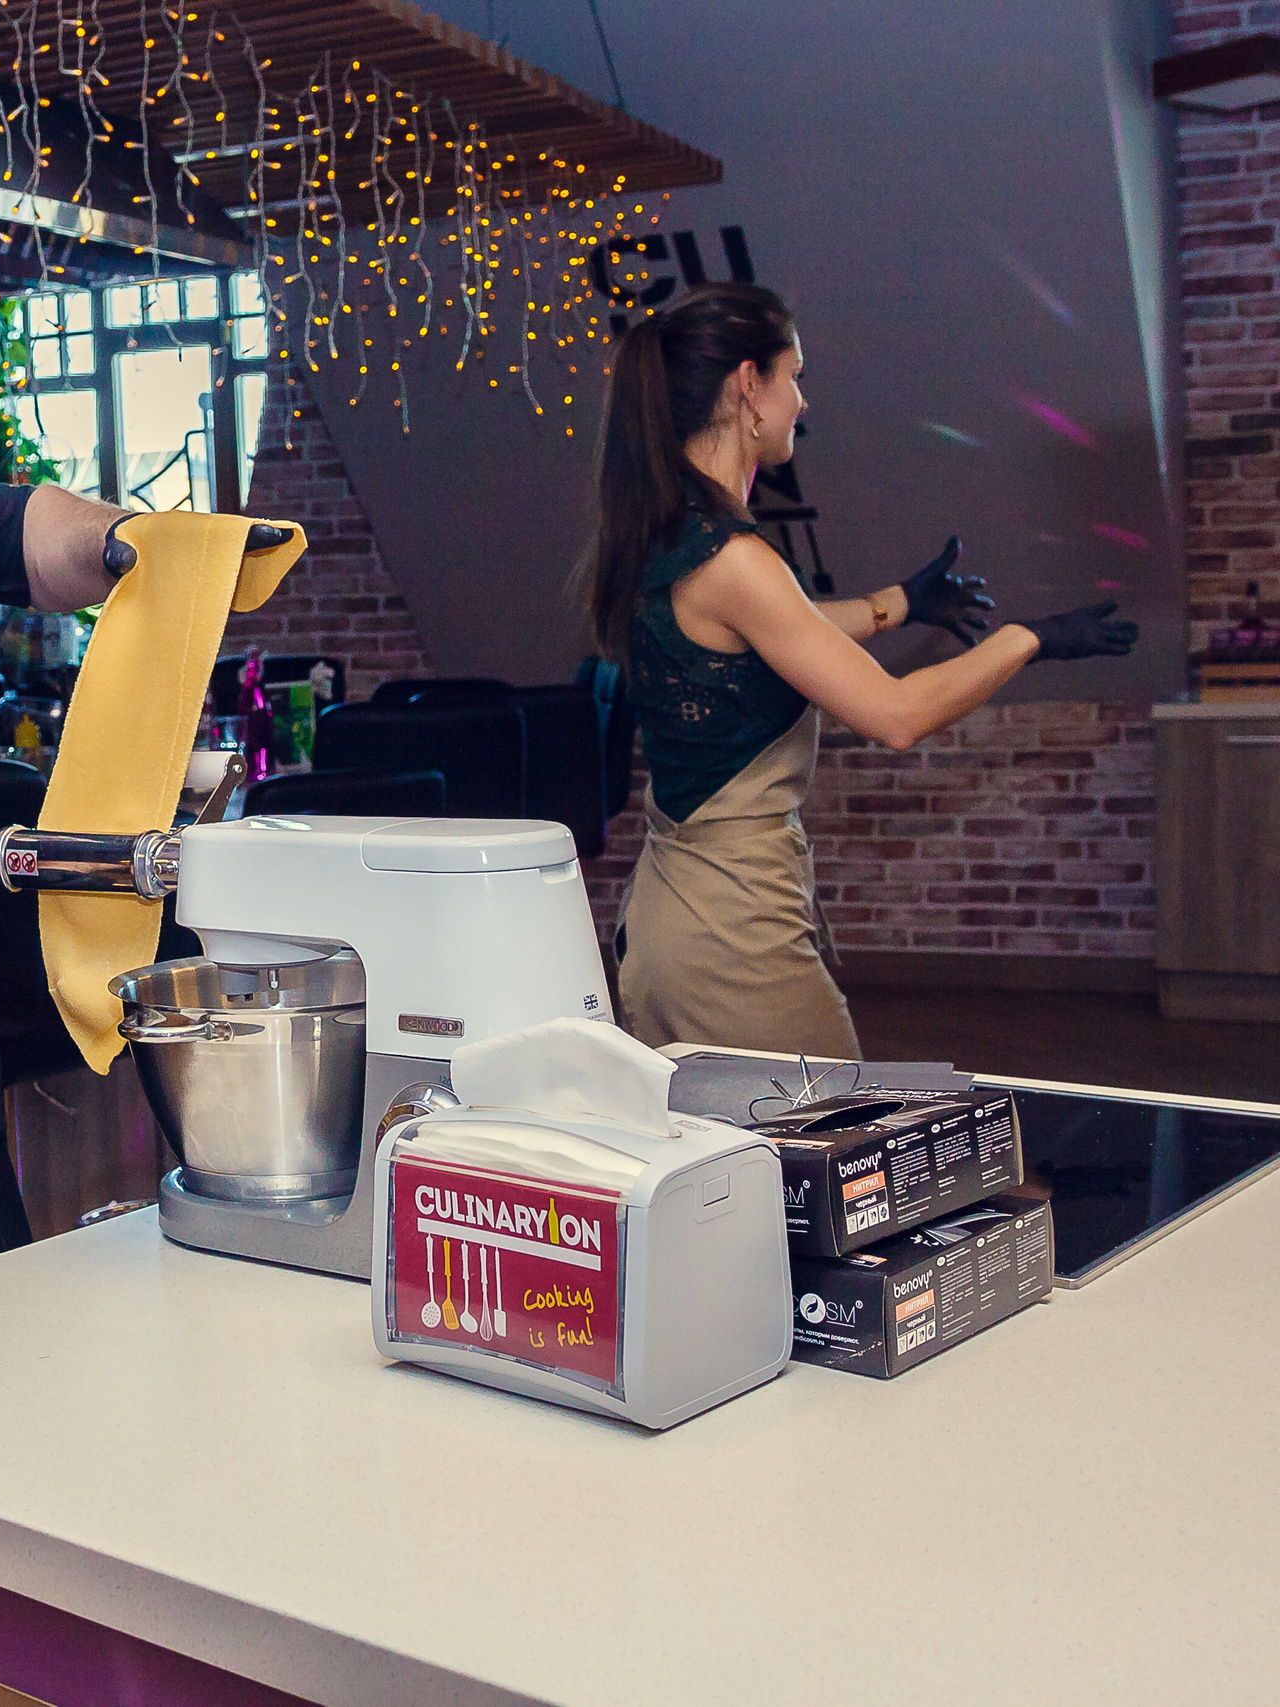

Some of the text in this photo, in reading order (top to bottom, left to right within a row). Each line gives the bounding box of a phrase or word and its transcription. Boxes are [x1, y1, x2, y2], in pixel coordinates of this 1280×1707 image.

[405, 1018, 455, 1033] KENWOOD
[852, 1176, 880, 1194] НИТРИЛ
[414, 1185, 602, 1252] CULINARY ON
[904, 1295, 929, 1314] НИТРИЛ
[528, 1327, 545, 1348] is
